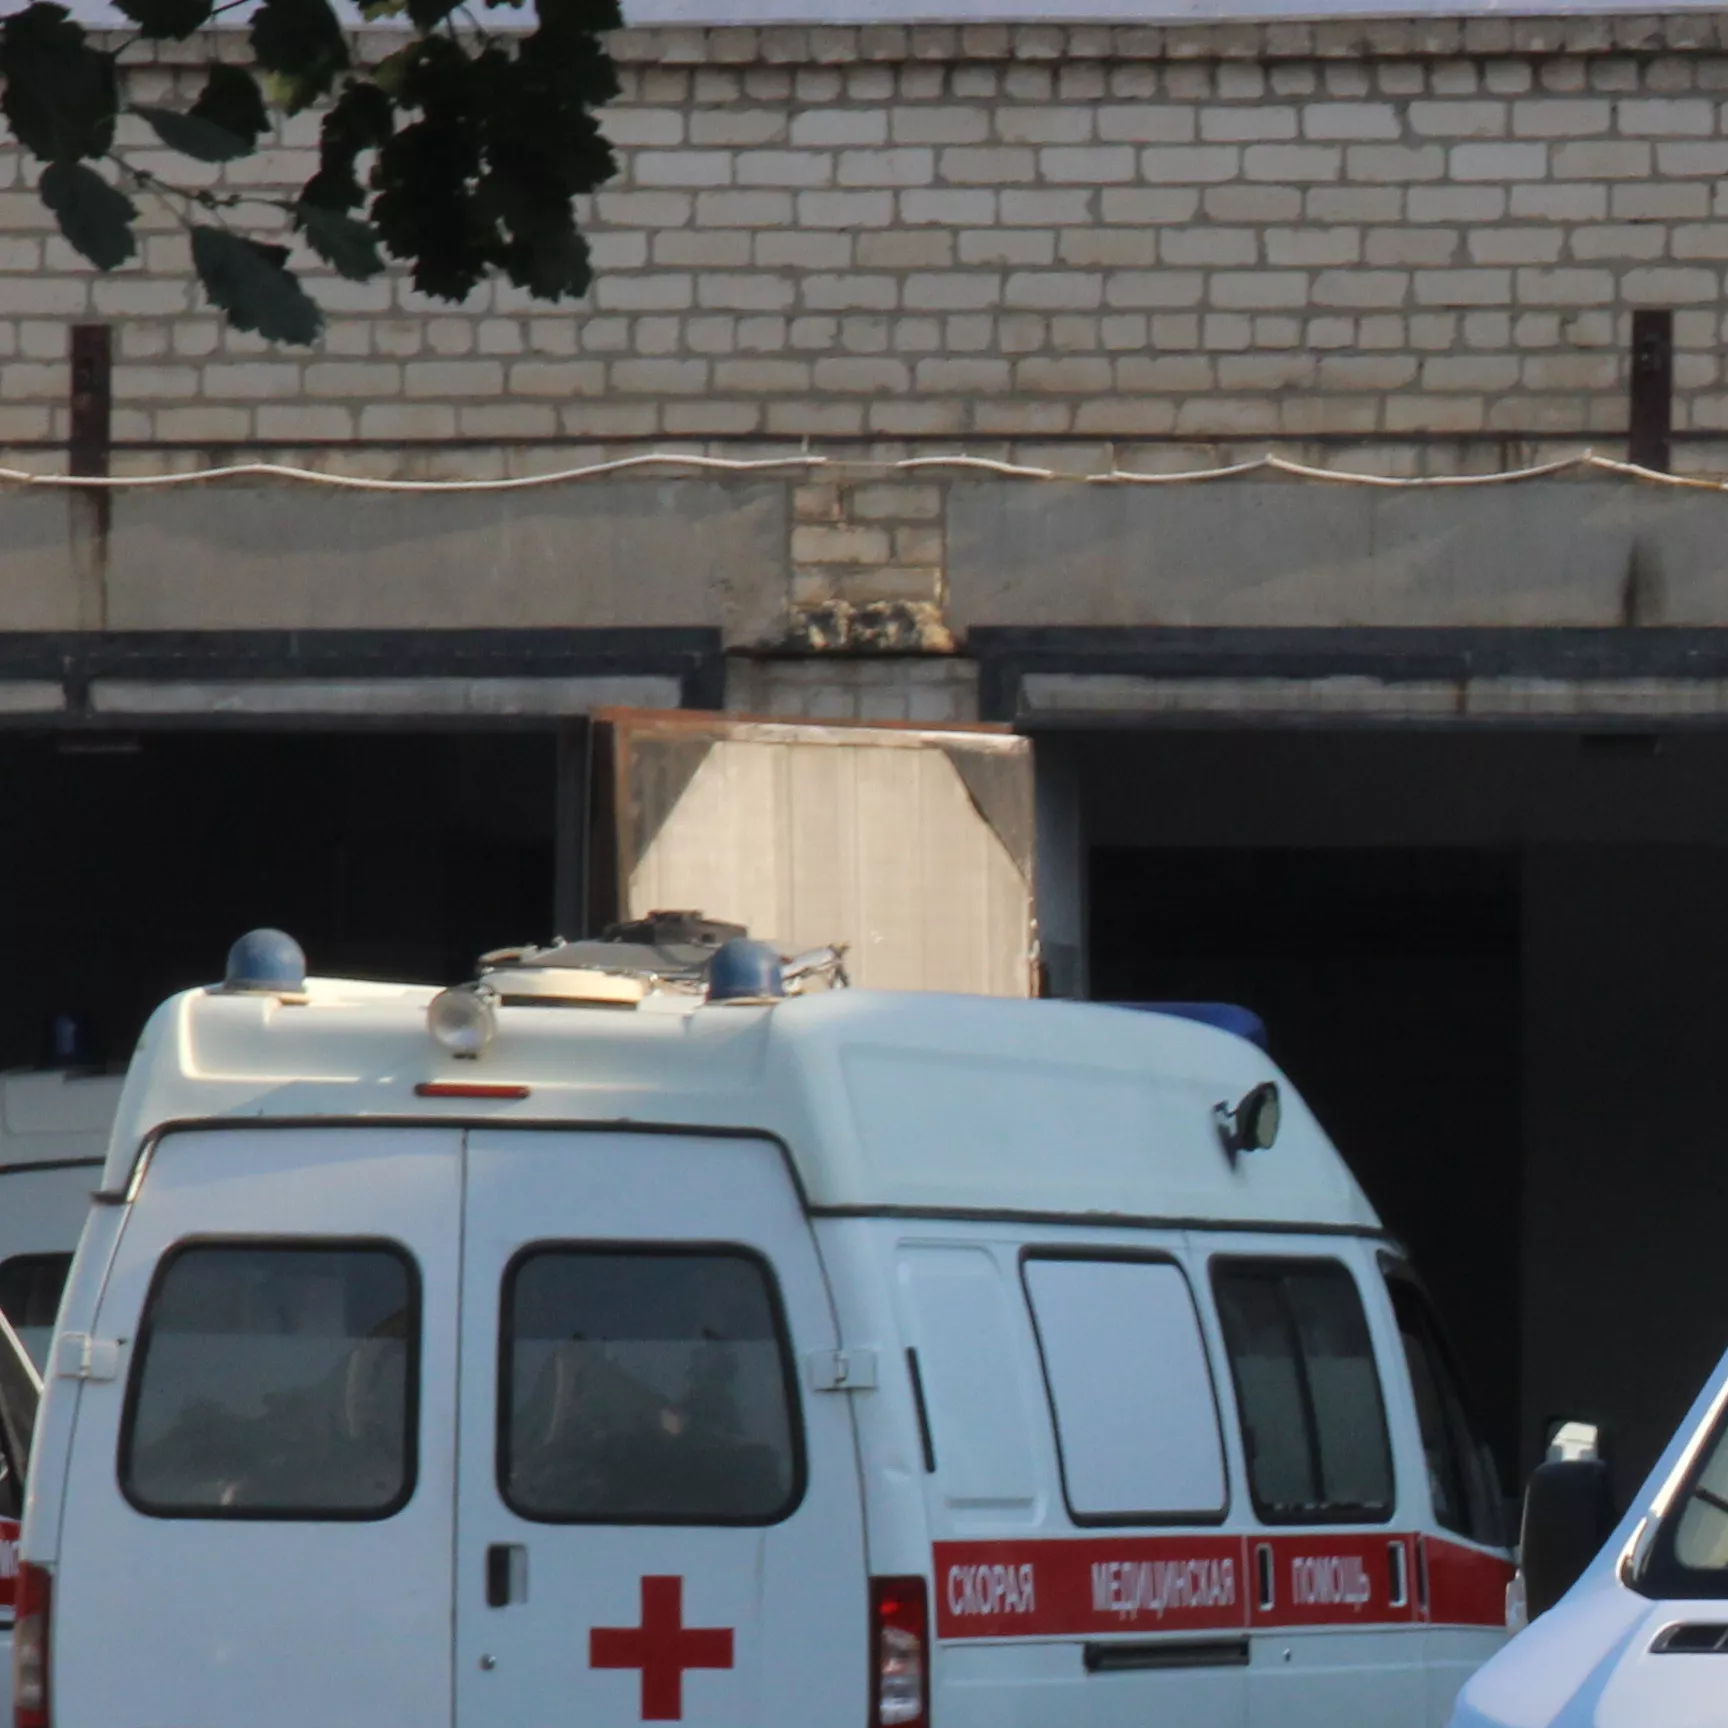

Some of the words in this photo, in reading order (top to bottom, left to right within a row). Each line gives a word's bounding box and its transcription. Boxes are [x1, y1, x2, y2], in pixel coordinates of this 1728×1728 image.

[946, 1562, 1036, 1617] СКОРАЯ
[1090, 1556, 1236, 1621] МЕДИЦИНСКАЯ
[1290, 1554, 1372, 1613] ПОМОЩЬ
